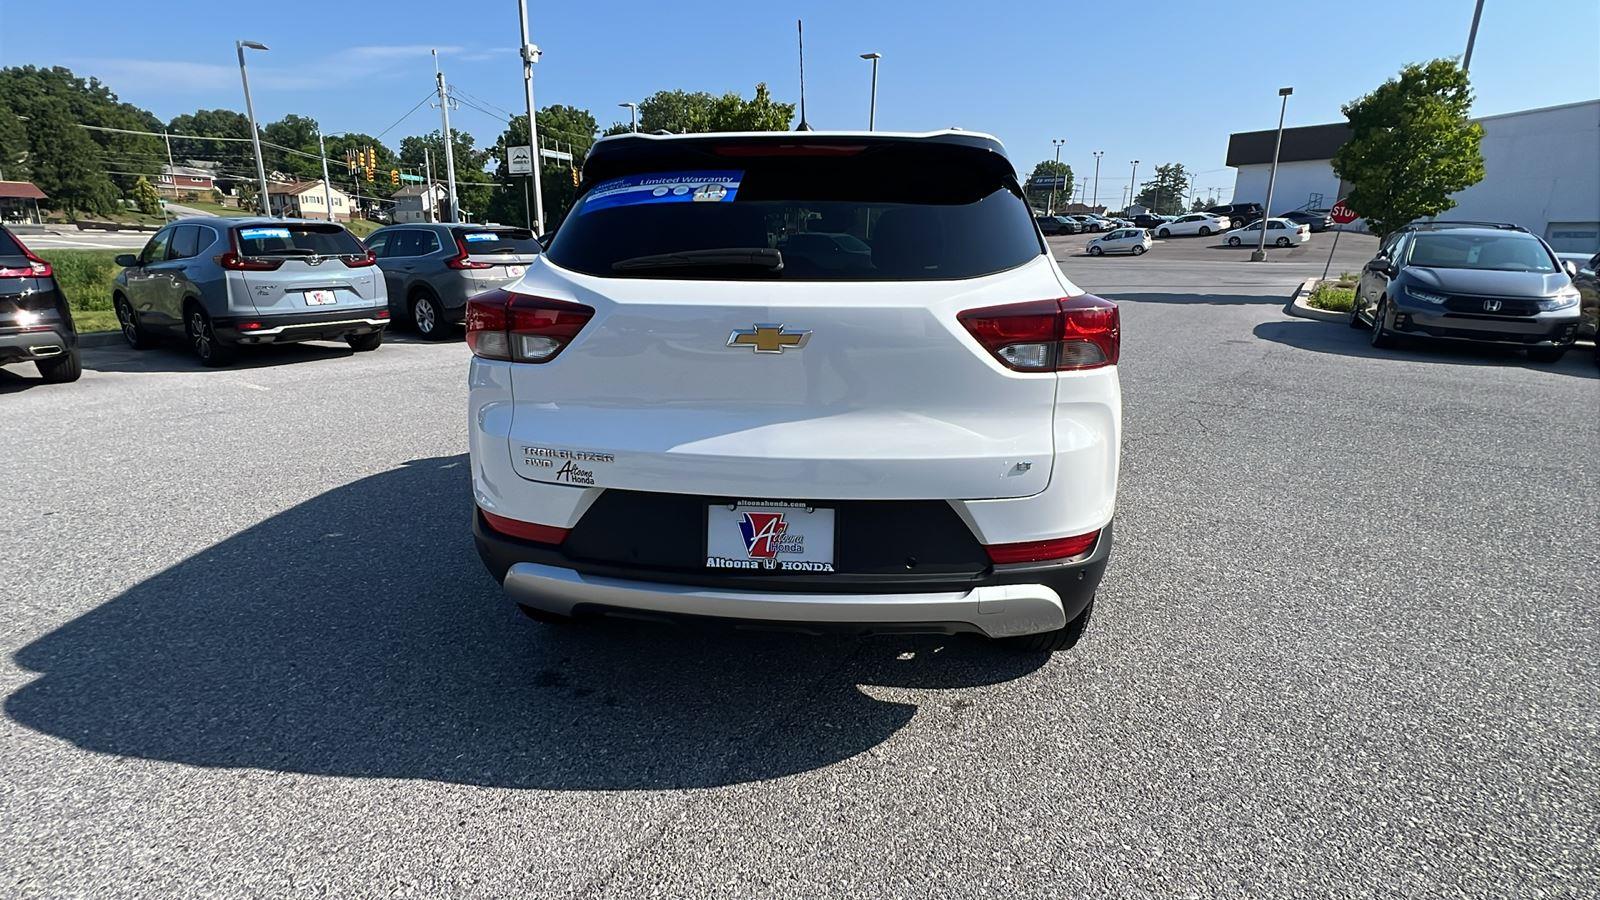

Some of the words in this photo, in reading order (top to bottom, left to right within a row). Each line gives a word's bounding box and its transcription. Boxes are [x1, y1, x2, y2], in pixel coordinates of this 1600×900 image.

[640, 176, 680, 186] Limited
[682, 175, 734, 184] Warranty
[1332, 206, 1355, 217] STO
[556, 460, 593, 482] Altoona
[571, 475, 595, 485] Honda
[737, 499, 806, 508] altoonahonda.com
[749, 517, 804, 552] Altoona
[770, 541, 804, 553] Honda
[706, 557, 759, 569] Altoona
[781, 562, 835, 572] HONDA
